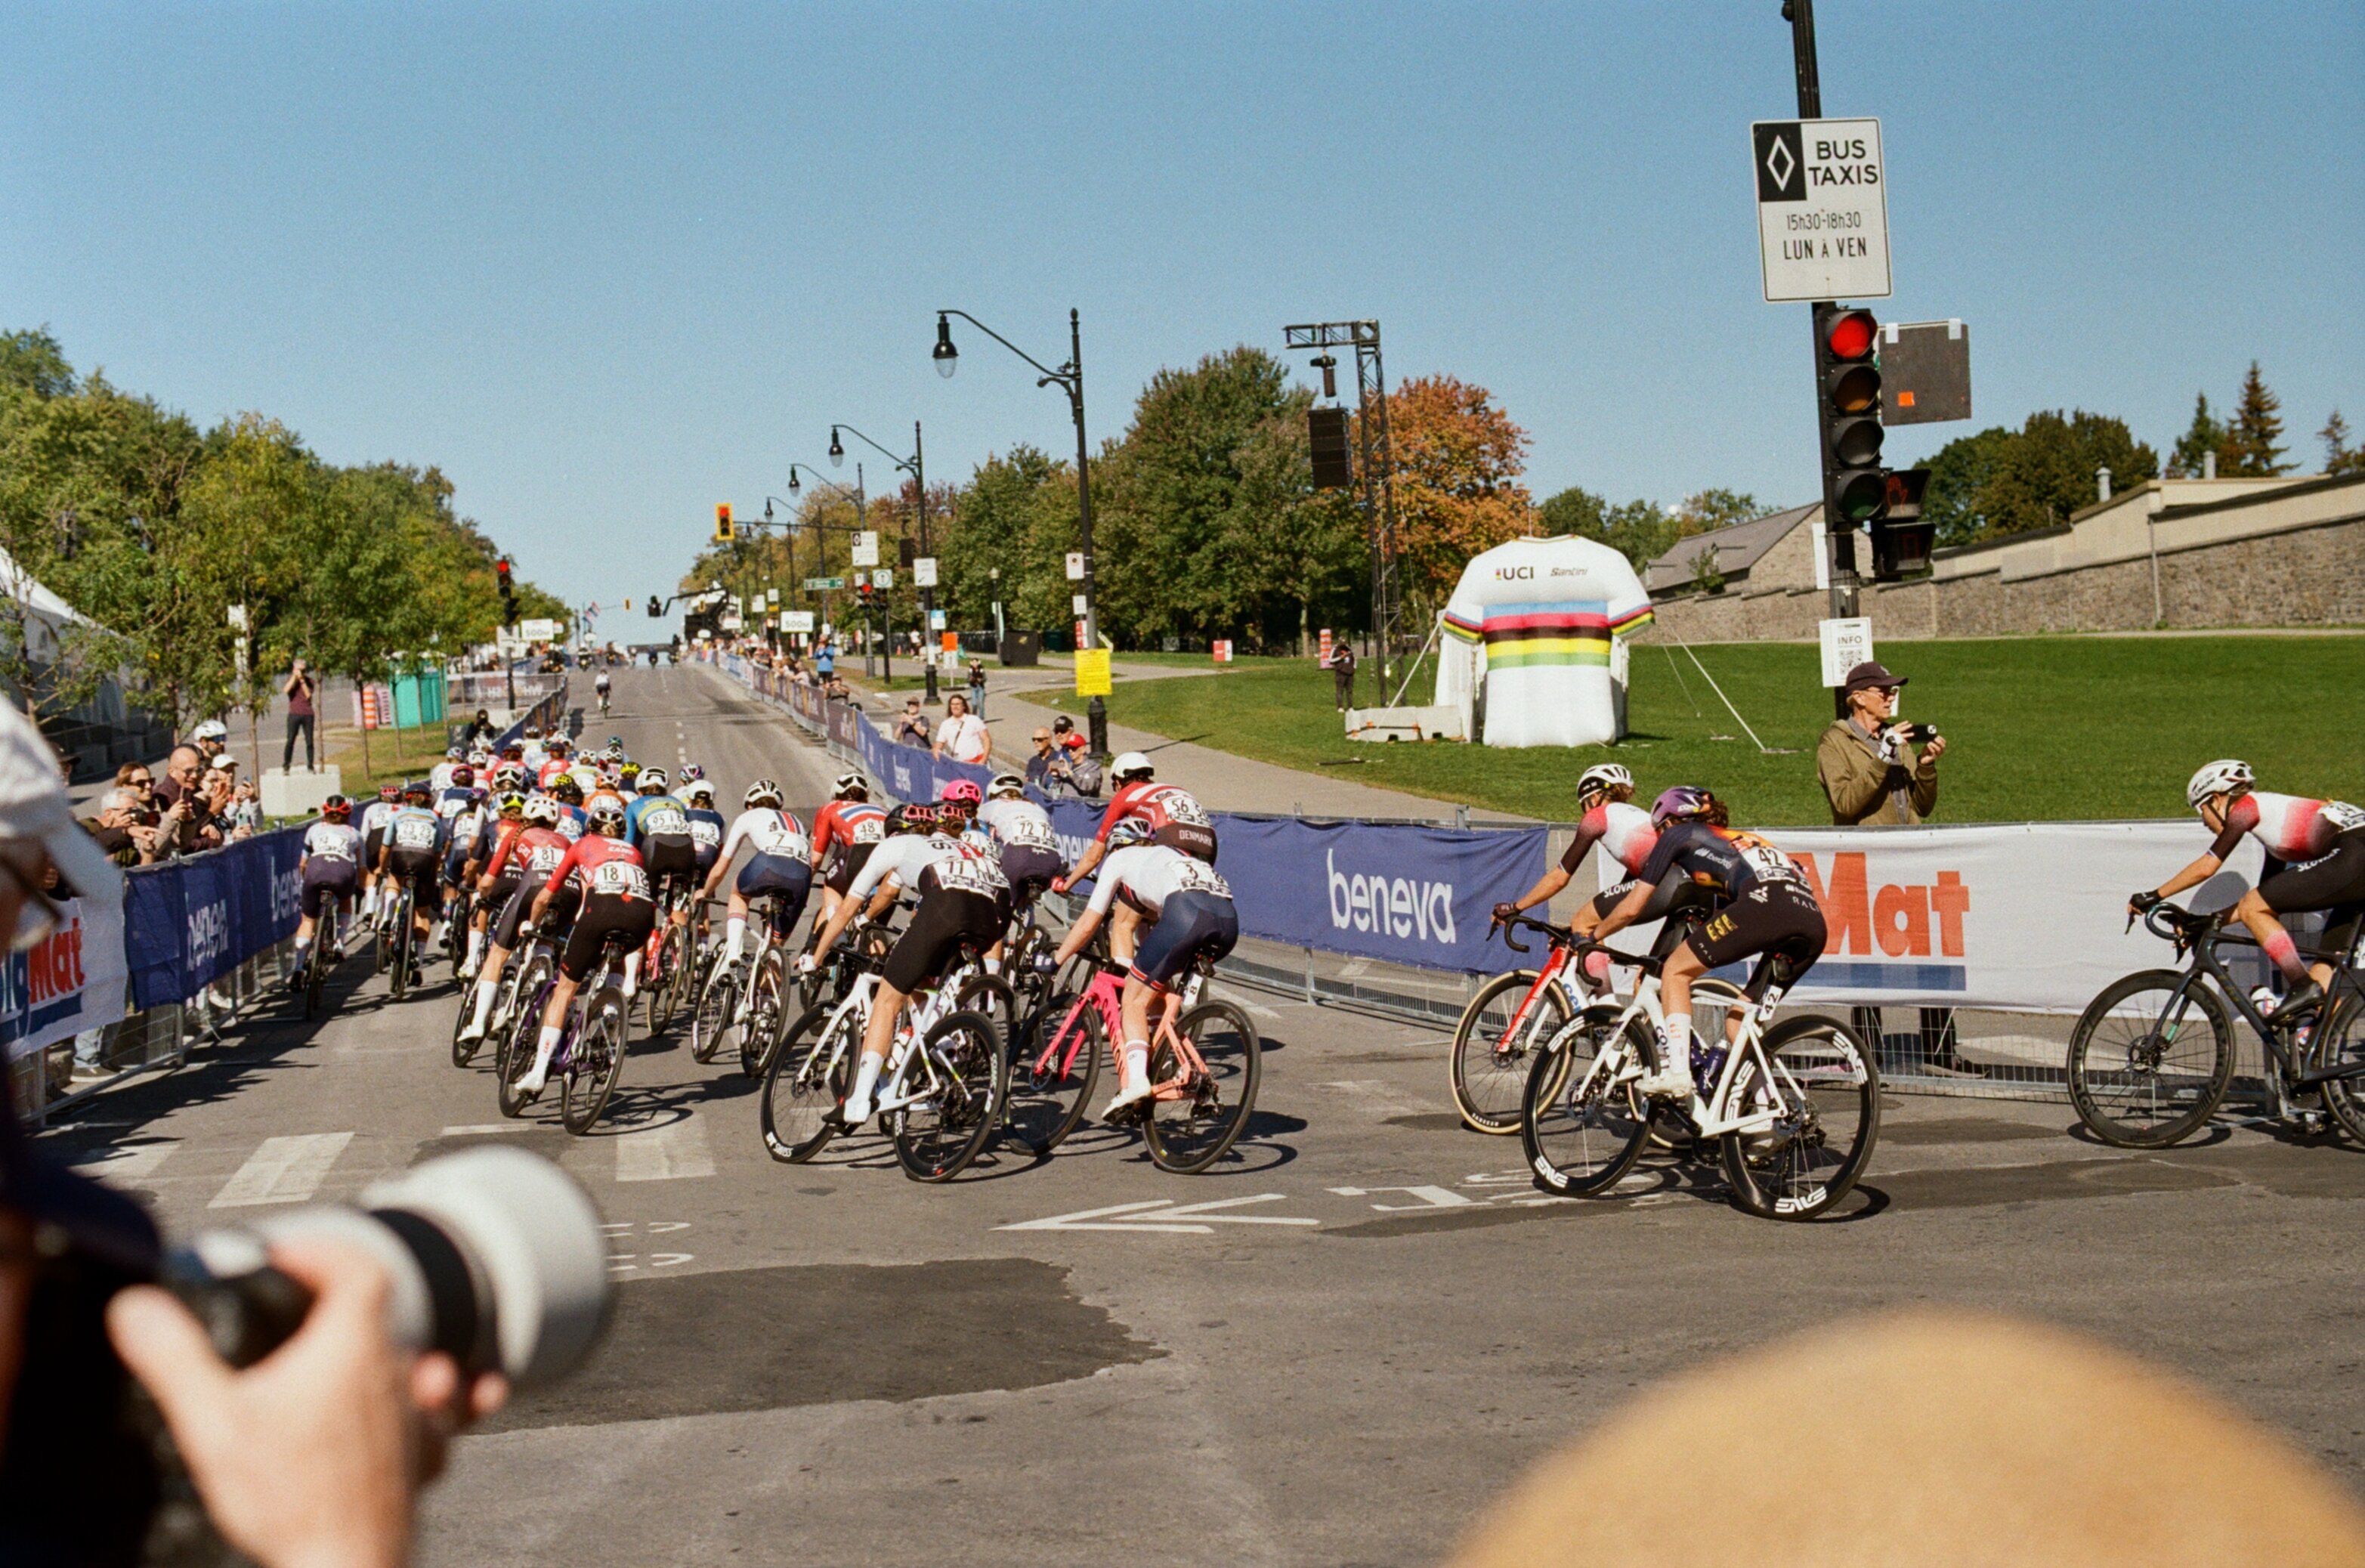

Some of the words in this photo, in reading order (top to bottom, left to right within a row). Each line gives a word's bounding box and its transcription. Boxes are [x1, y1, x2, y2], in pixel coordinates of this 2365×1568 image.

[1816, 140, 1866, 160] BUS
[1808, 165, 1878, 186] TAXIS
[1786, 212, 1861, 230] 15h30-18h30
[1784, 240, 1813, 260] LUN
[1822, 239, 1829, 258] À
[1837, 237, 1867, 257] VEN
[1503, 566, 1535, 580] UCI
[1550, 567, 1589, 577] Santini
[1838, 636, 1863, 645] INFO
[1171, 799, 1189, 813] 56
[403, 824, 415, 835] 23
[860, 822, 875, 833] 48
[1019, 821, 1034, 835] 72
[776, 833, 784, 846] 7
[1179, 830, 1213, 848] DENMARK
[541, 848, 555, 861] 81
[1759, 849, 1783, 867] 42
[603, 868, 619, 880] 18
[945, 861, 964, 874] 77
[1327, 848, 1456, 944] beneva
[1787, 852, 1970, 957] Mat
[1764, 993, 1778, 1014] 42
[1548, 1015, 1584, 1053] ENVE
[1832, 1030, 1869, 1086] ENVE
[773, 1142, 794, 1158] SWISS
[1535, 1155, 1569, 1189] ENVE
[1774, 1186, 1828, 1214] ENVE
